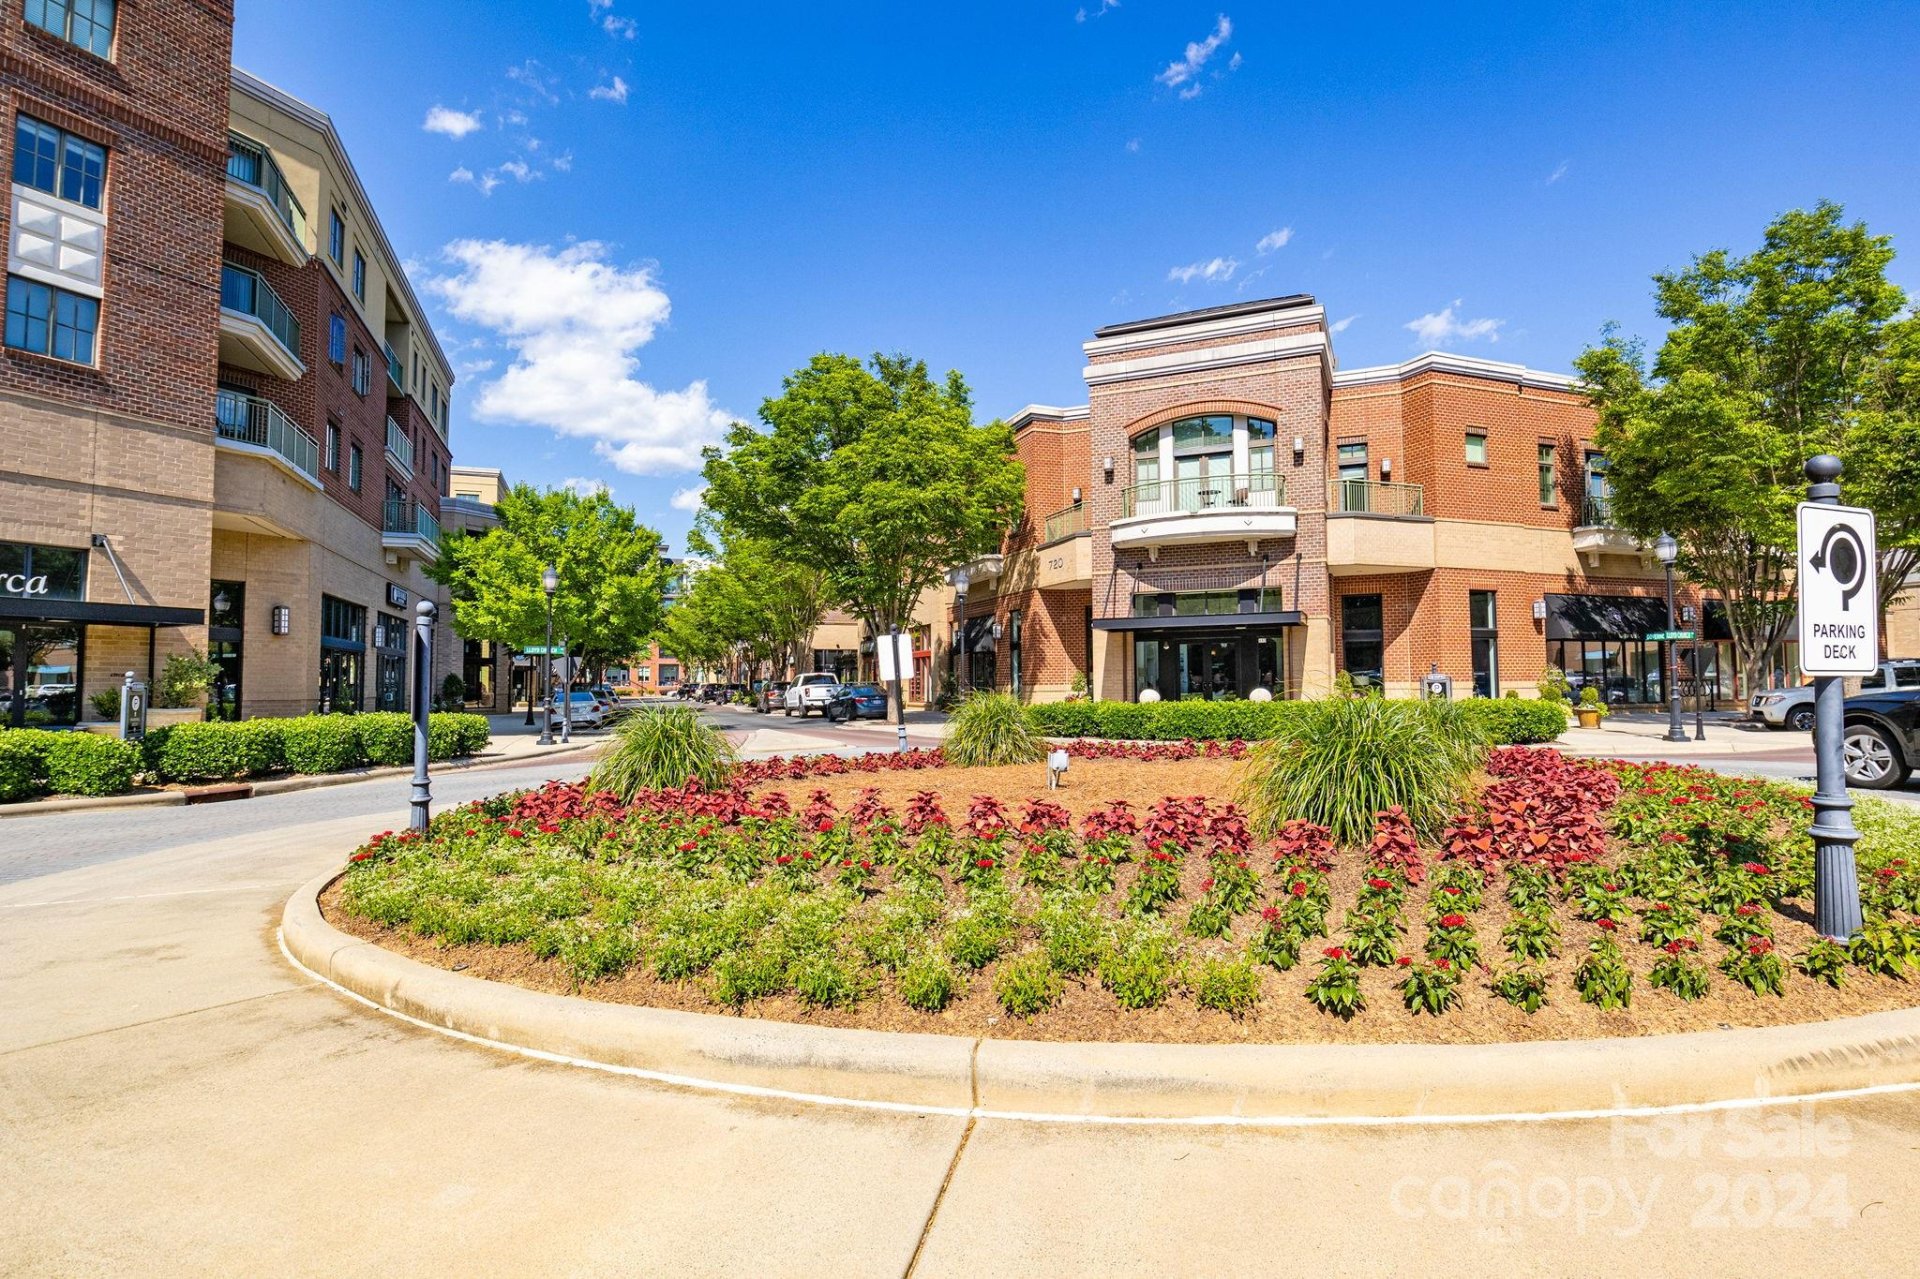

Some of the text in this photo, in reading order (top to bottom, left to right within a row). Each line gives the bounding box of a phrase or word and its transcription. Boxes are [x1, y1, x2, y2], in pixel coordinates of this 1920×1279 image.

[1049, 558, 1063, 570] 720
[1814, 624, 1865, 638] PARKING
[1824, 645, 1856, 659] DECK
